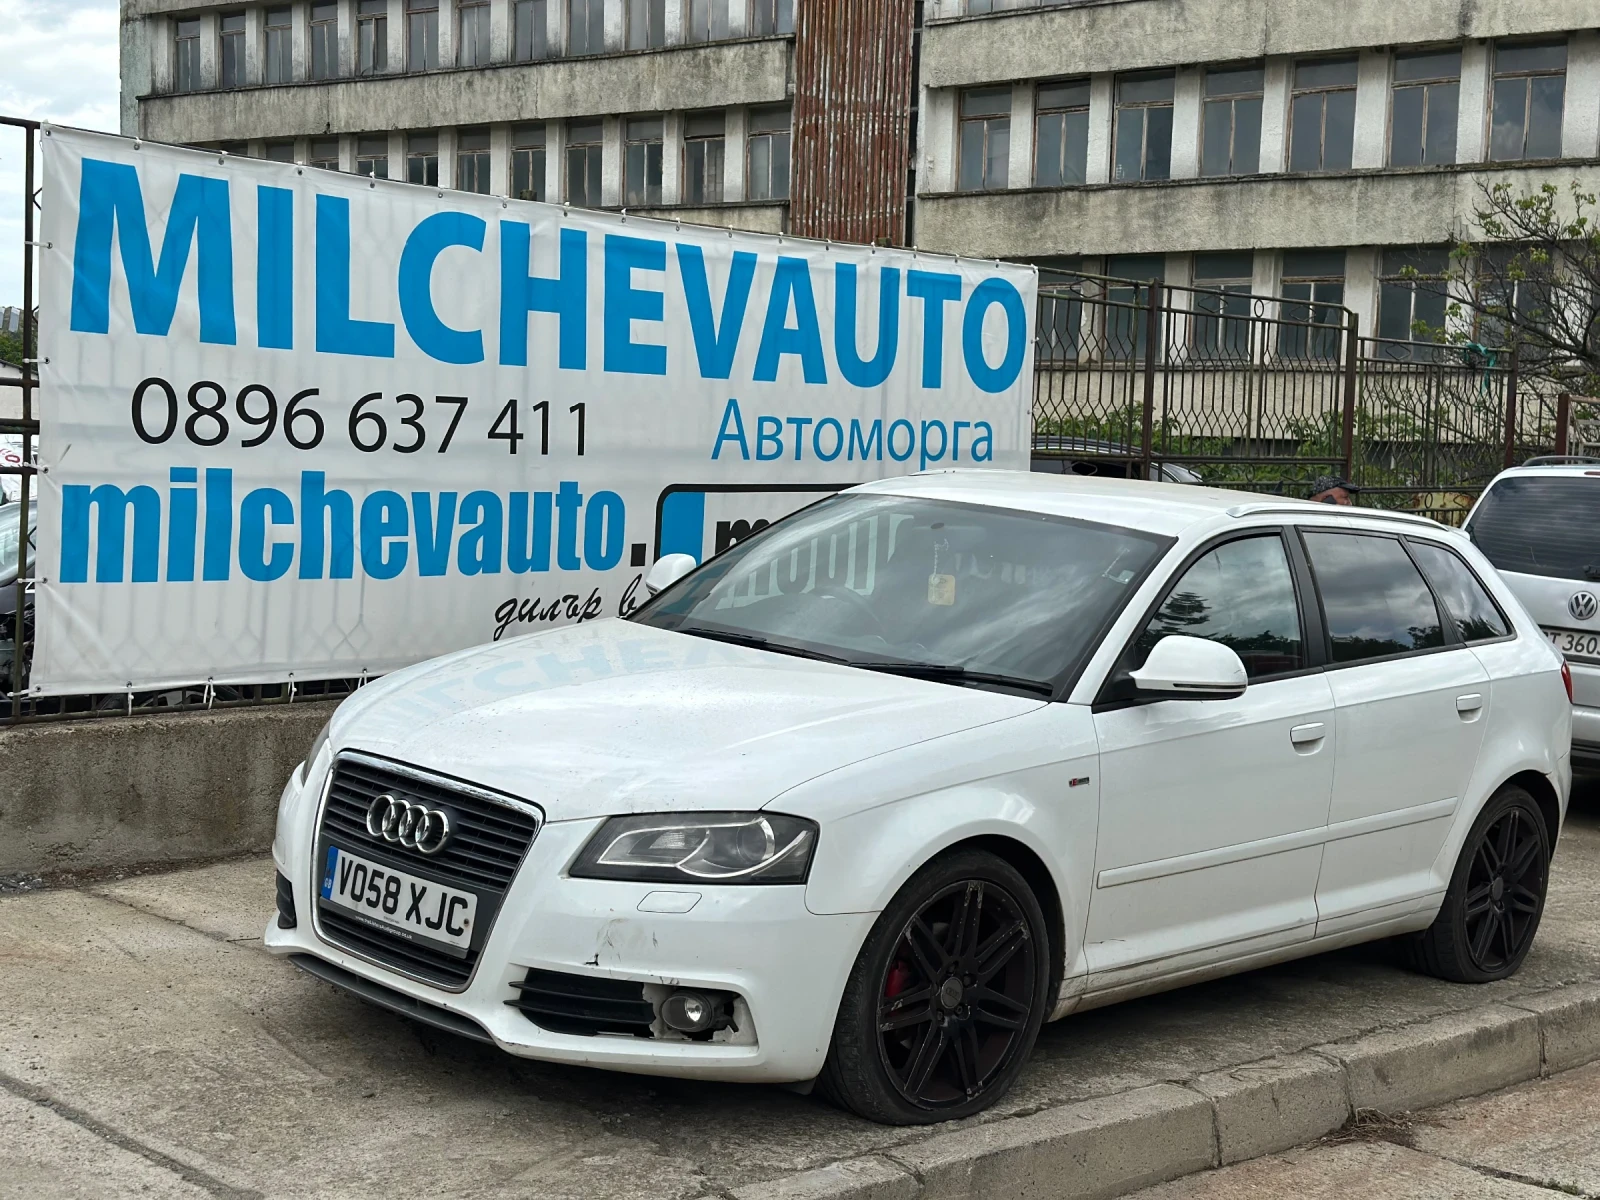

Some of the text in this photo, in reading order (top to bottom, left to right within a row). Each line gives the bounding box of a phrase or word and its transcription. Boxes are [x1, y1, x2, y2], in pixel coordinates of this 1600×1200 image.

[70, 157, 1027, 394] MILCHEVAUTO
[132, 378, 585, 455] 0896 637 411
[712, 398, 993, 471] Автоморга
[1562, 633, 1600, 656] 360
[405, 882, 468, 937] XJC
